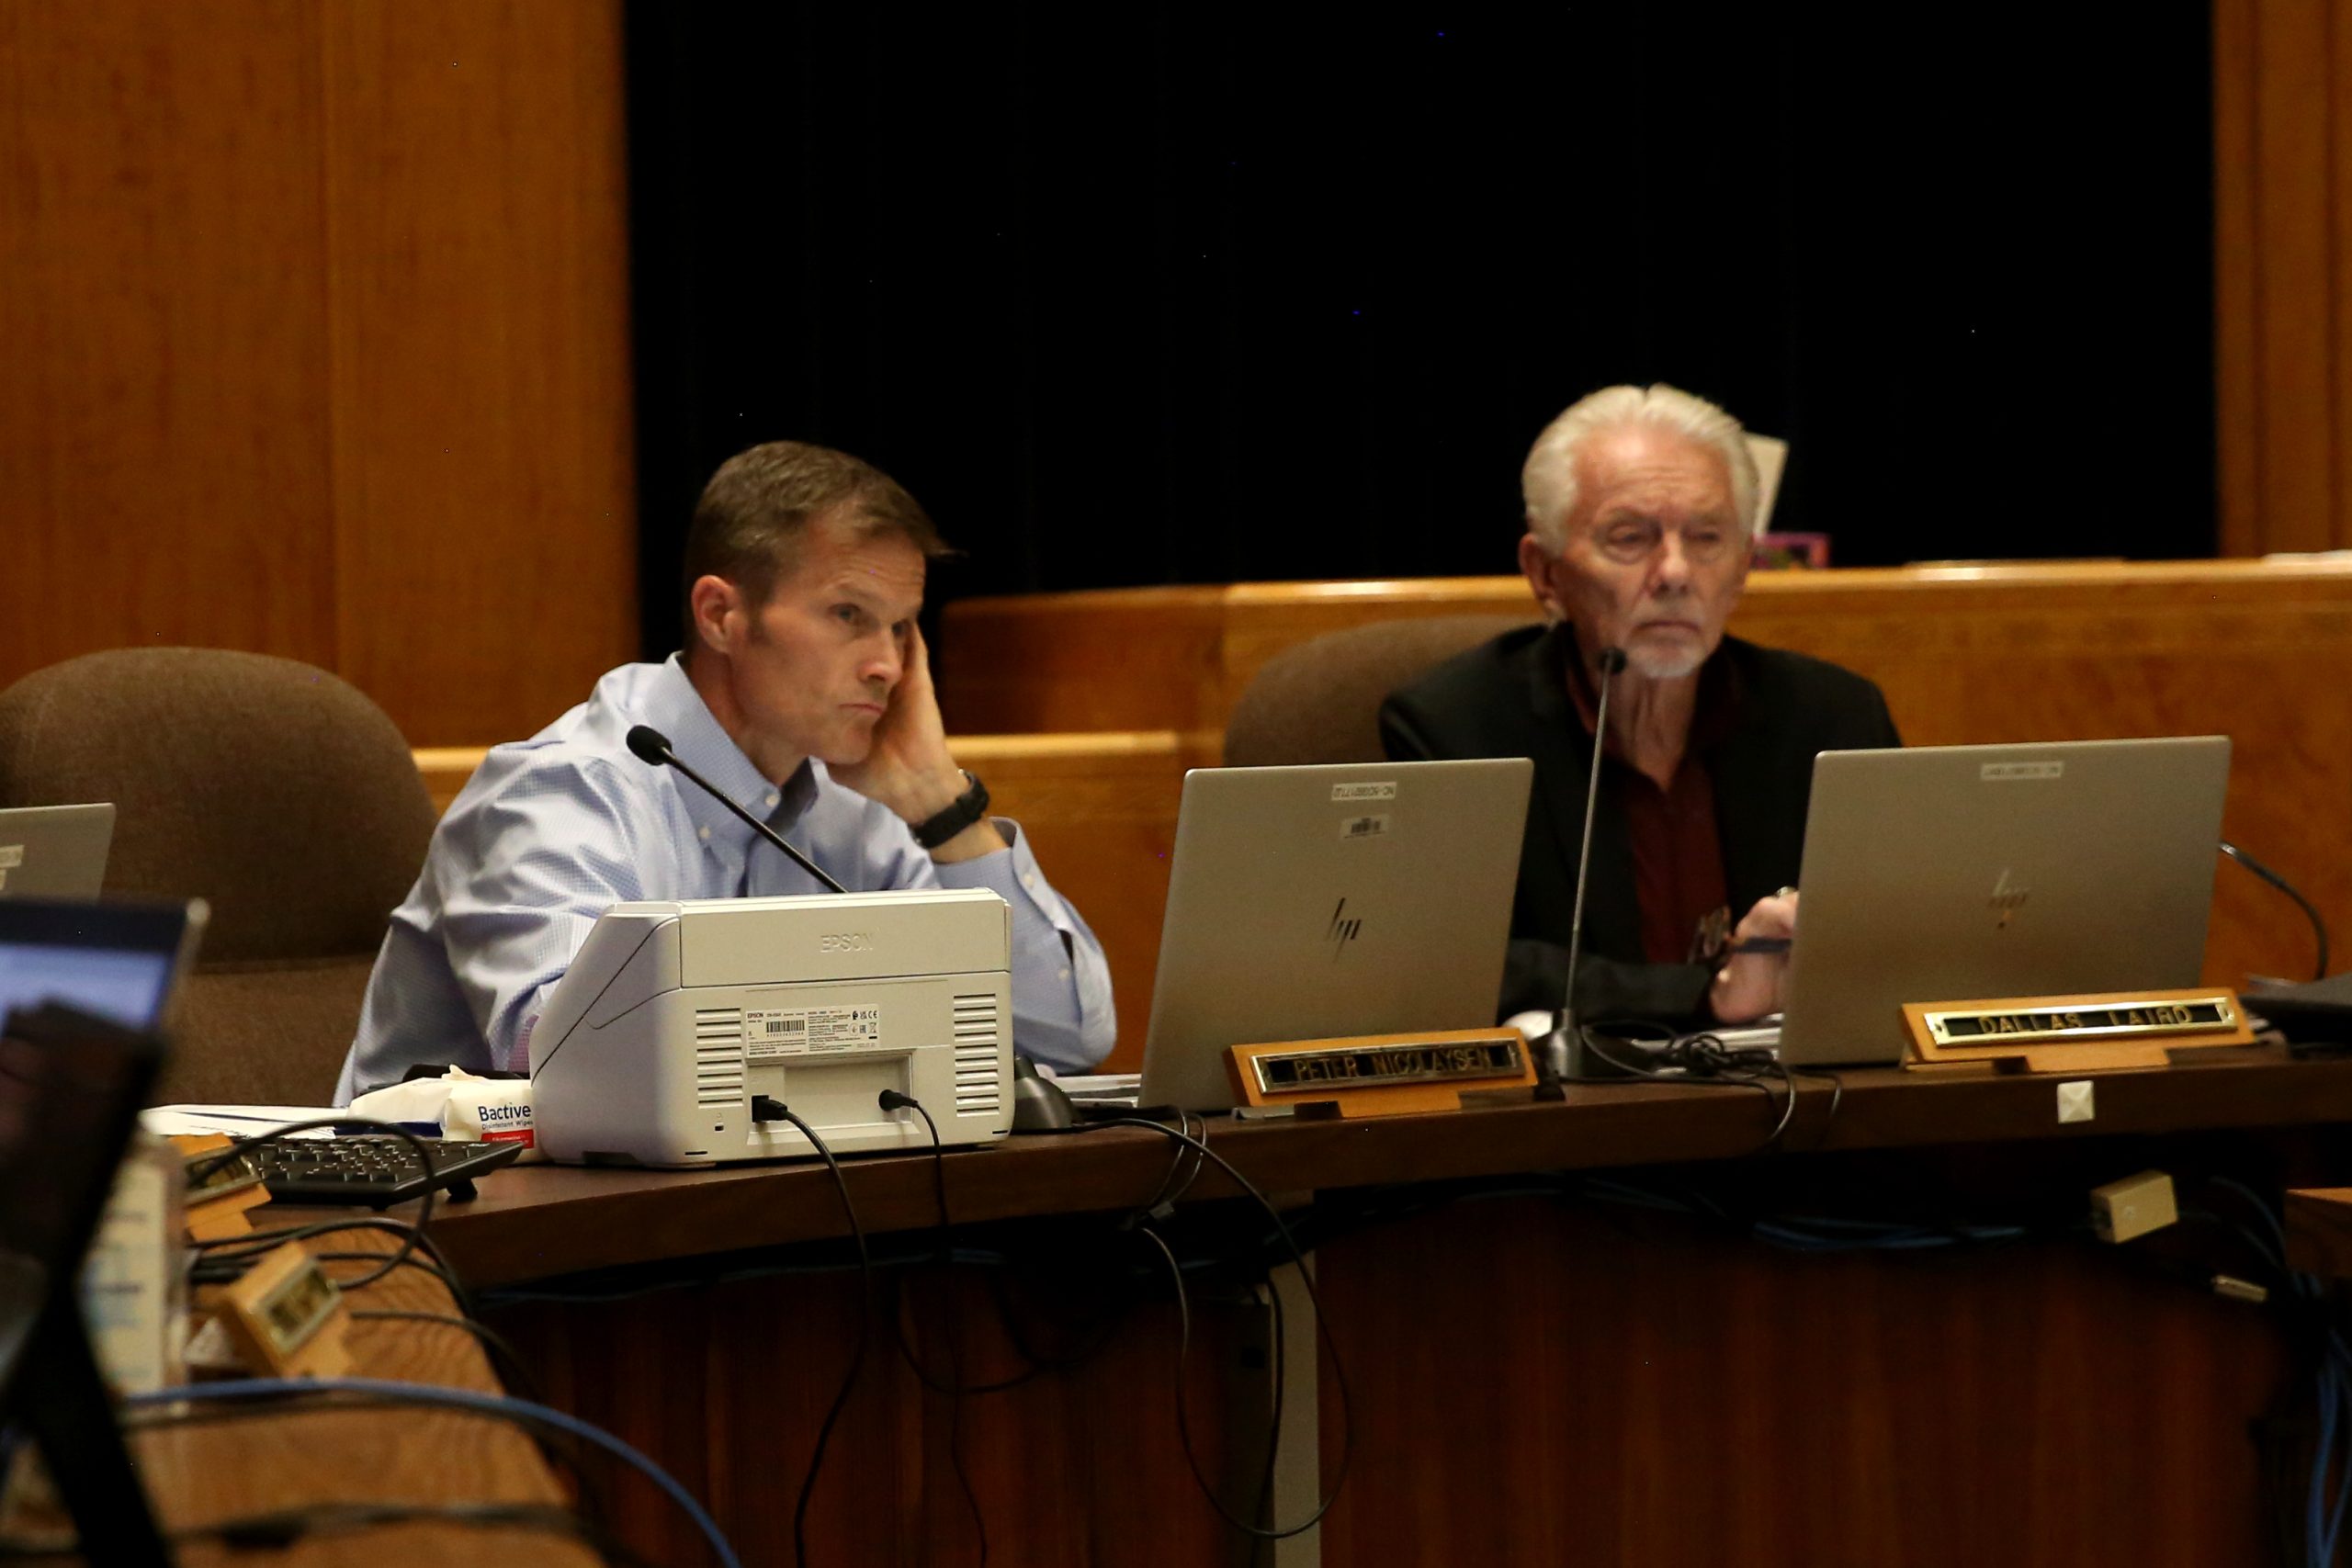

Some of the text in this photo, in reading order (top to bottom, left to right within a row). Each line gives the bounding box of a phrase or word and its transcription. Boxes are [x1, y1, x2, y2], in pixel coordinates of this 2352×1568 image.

[820, 932, 874, 953] EPSON
[1978, 1005, 2193, 1034] DALLAS LAIRD
[1295, 1056, 1359, 1081] PETER
[478, 1102, 531, 1122] Bactive
